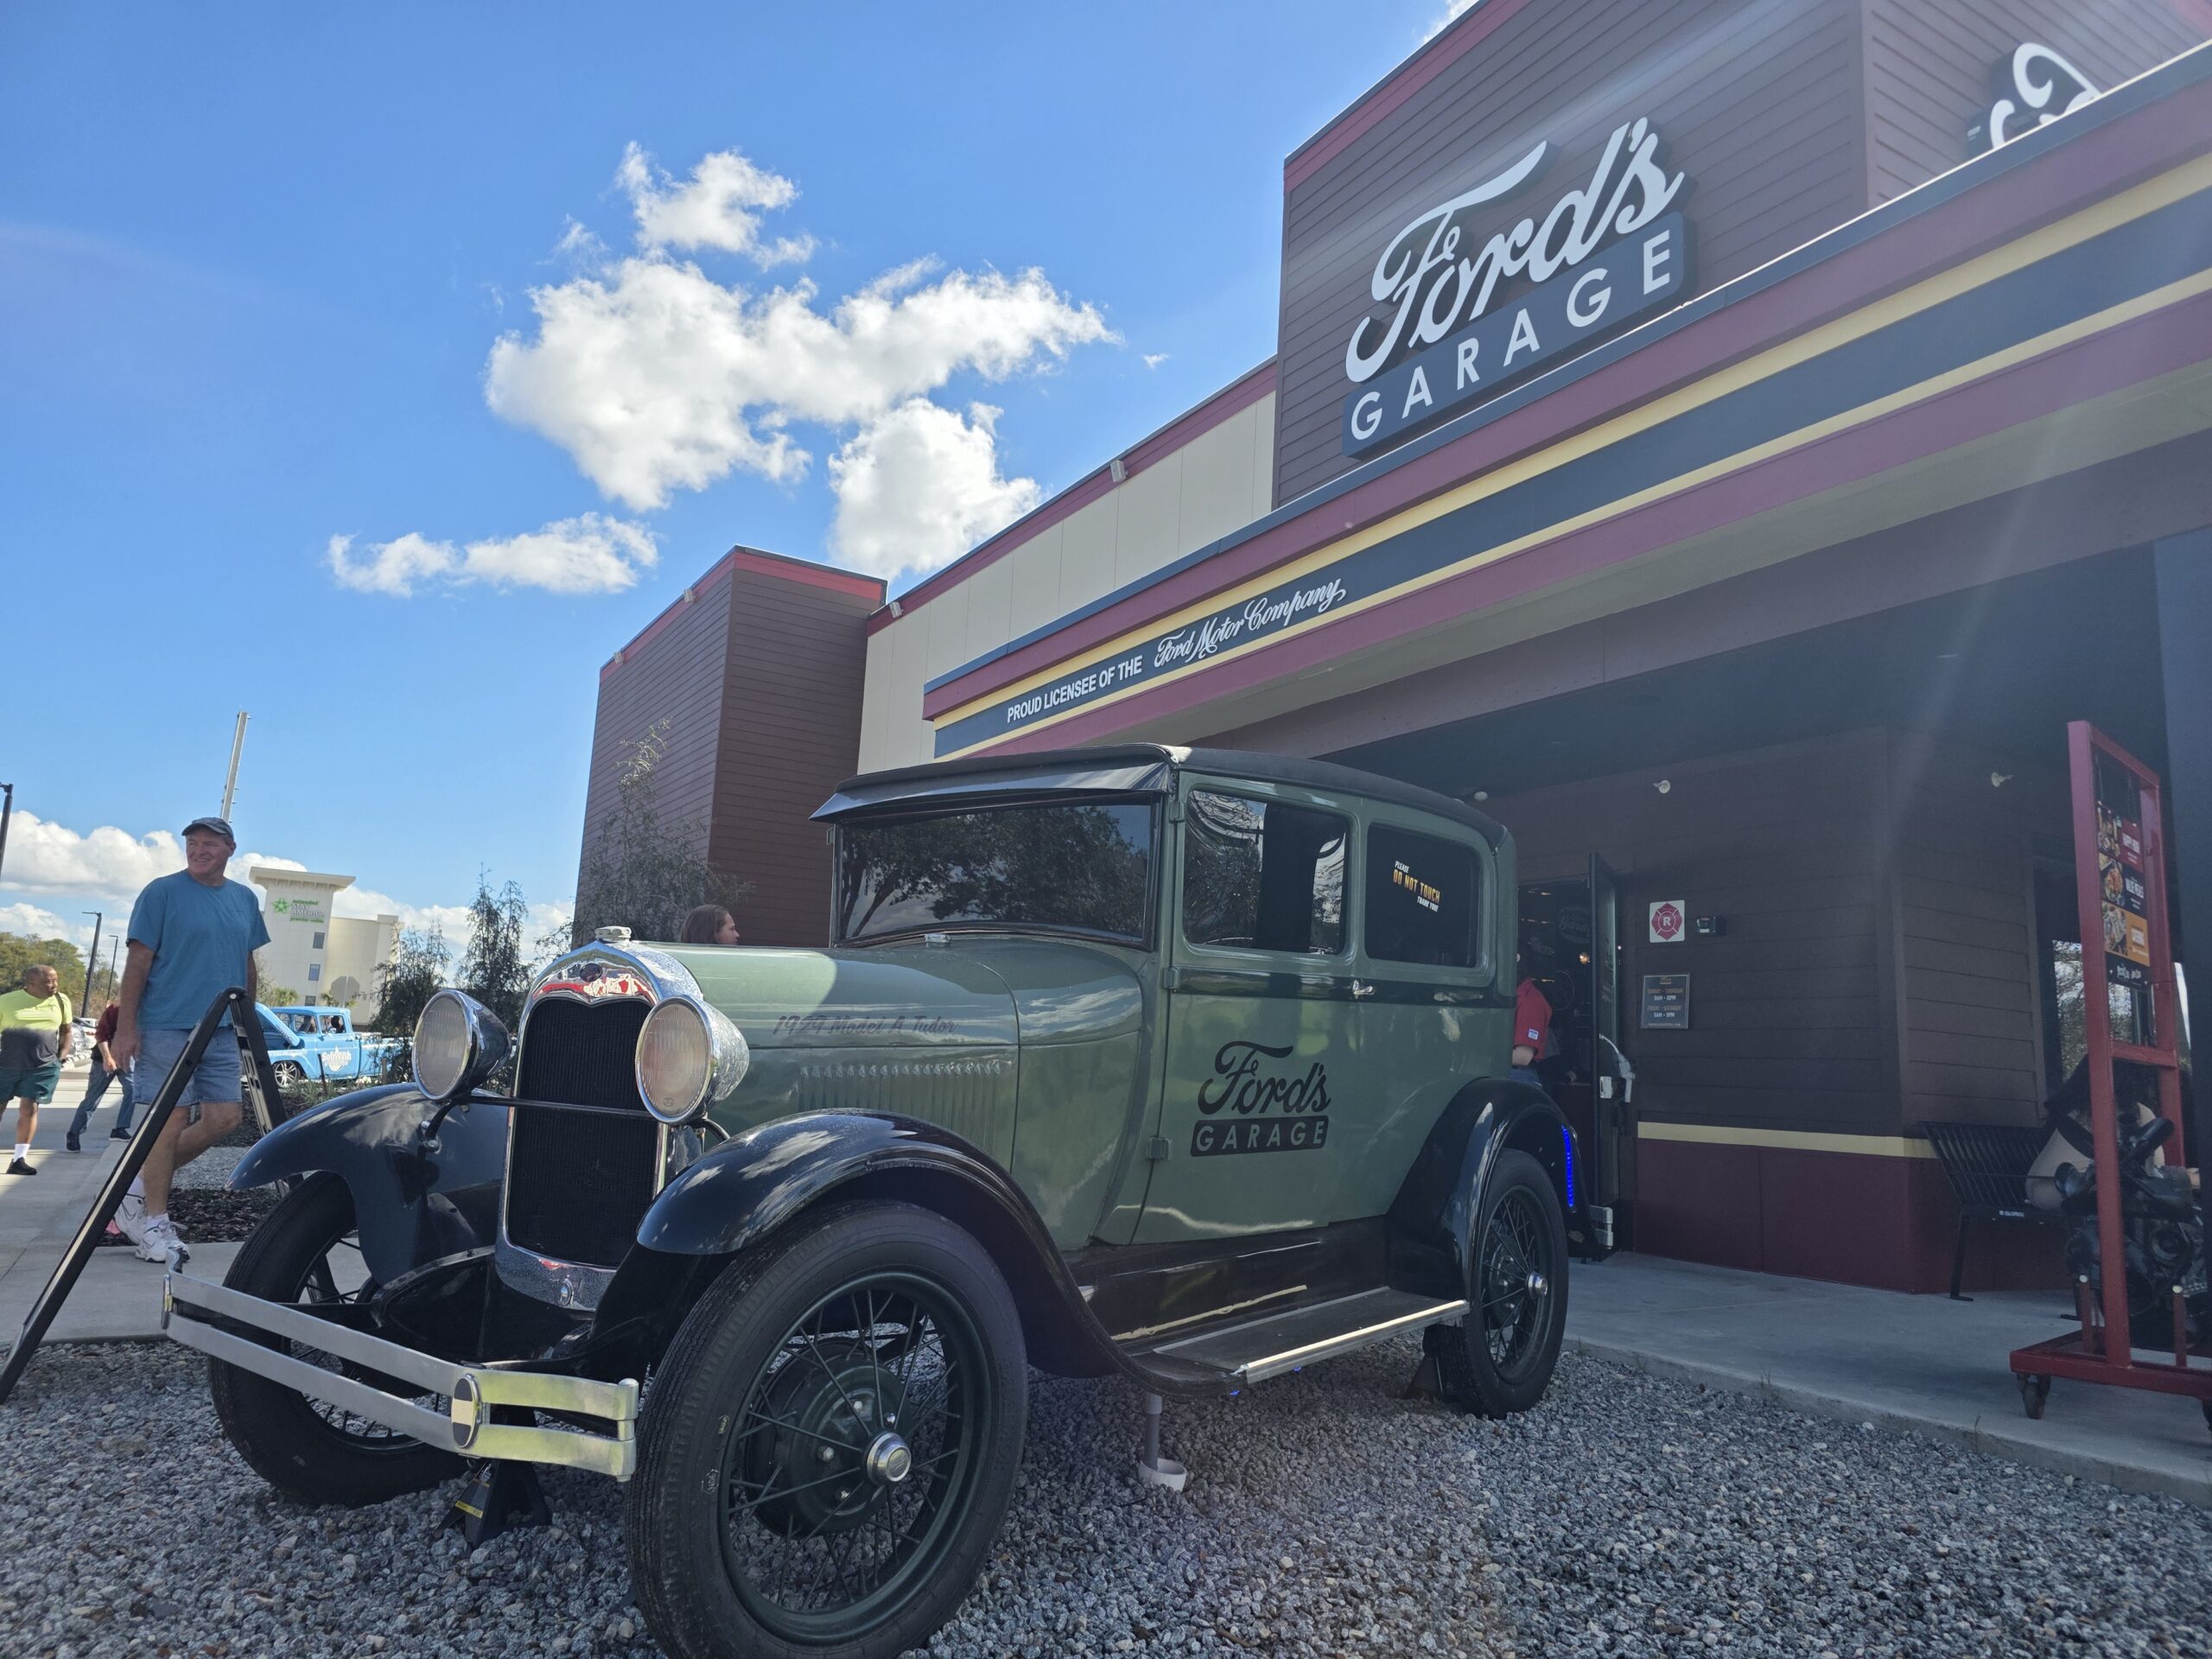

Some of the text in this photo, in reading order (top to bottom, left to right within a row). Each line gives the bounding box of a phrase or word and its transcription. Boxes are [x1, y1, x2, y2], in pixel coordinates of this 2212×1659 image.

[1345, 117, 1685, 383] Ford's
[1351, 229, 1670, 441] GARAGE
[1007, 578, 1347, 723] PROUD LICENSEE OF THE Ford Motor Company
[1394, 861, 1409, 874] PLEASE
[1393, 869, 1440, 903] DO NOT TOUCH
[1662, 916, 1672, 927] R
[827, 1015, 887, 1036] Model
[888, 1015, 906, 1035] A
[912, 1015, 959, 1034] Tudor
[1197, 1040, 1332, 1116] Ford's
[1195, 1121, 1325, 1152] GARAGE
